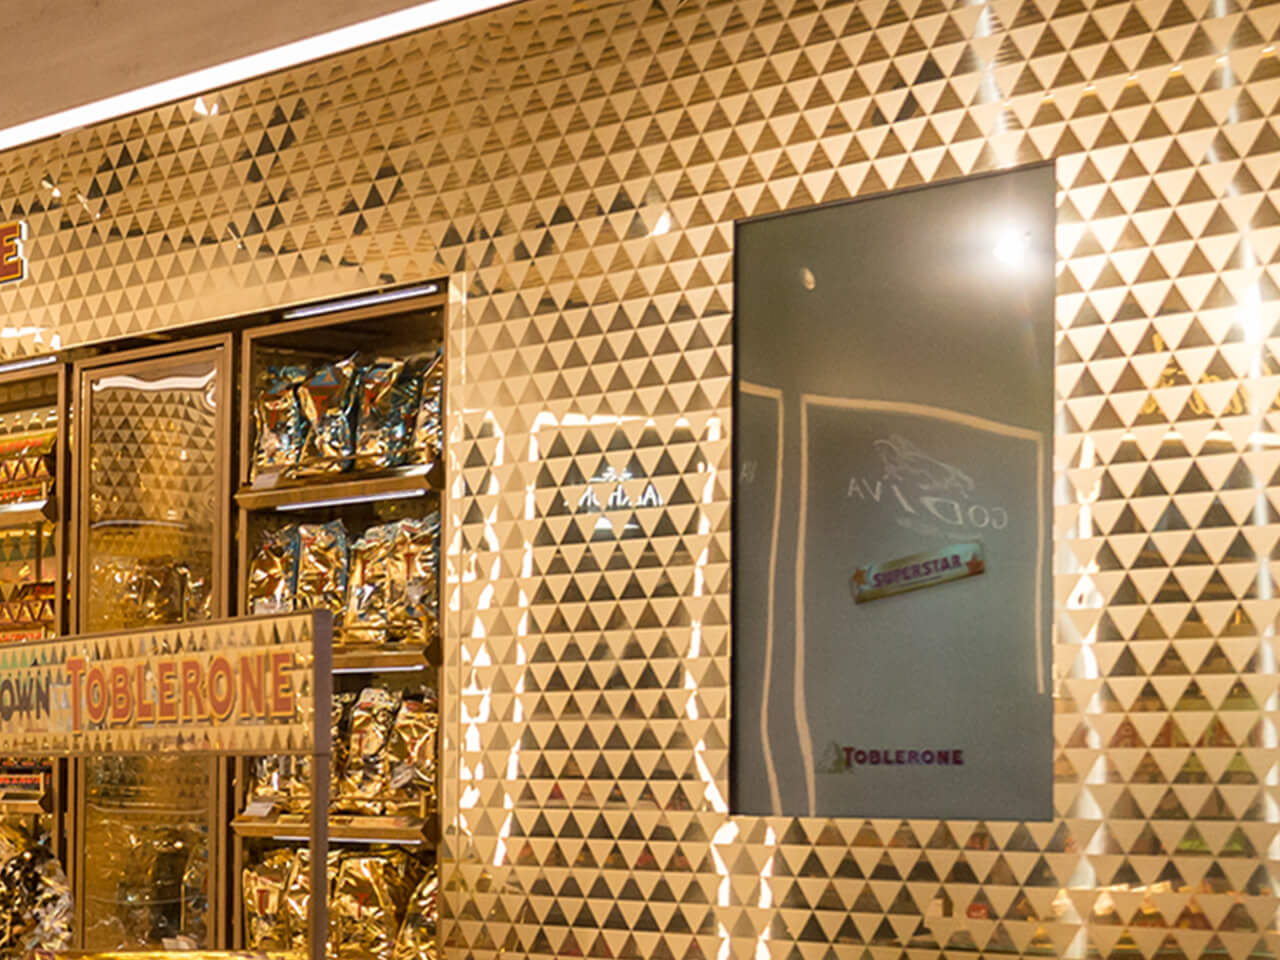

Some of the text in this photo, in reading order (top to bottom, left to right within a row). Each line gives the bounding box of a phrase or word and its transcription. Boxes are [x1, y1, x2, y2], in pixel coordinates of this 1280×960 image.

[873, 555, 962, 588] SUPERSTAR
[0, 676, 50, 722] OWN
[66, 651, 296, 736] TOBLERONE
[842, 746, 964, 768] TOBLERONE
